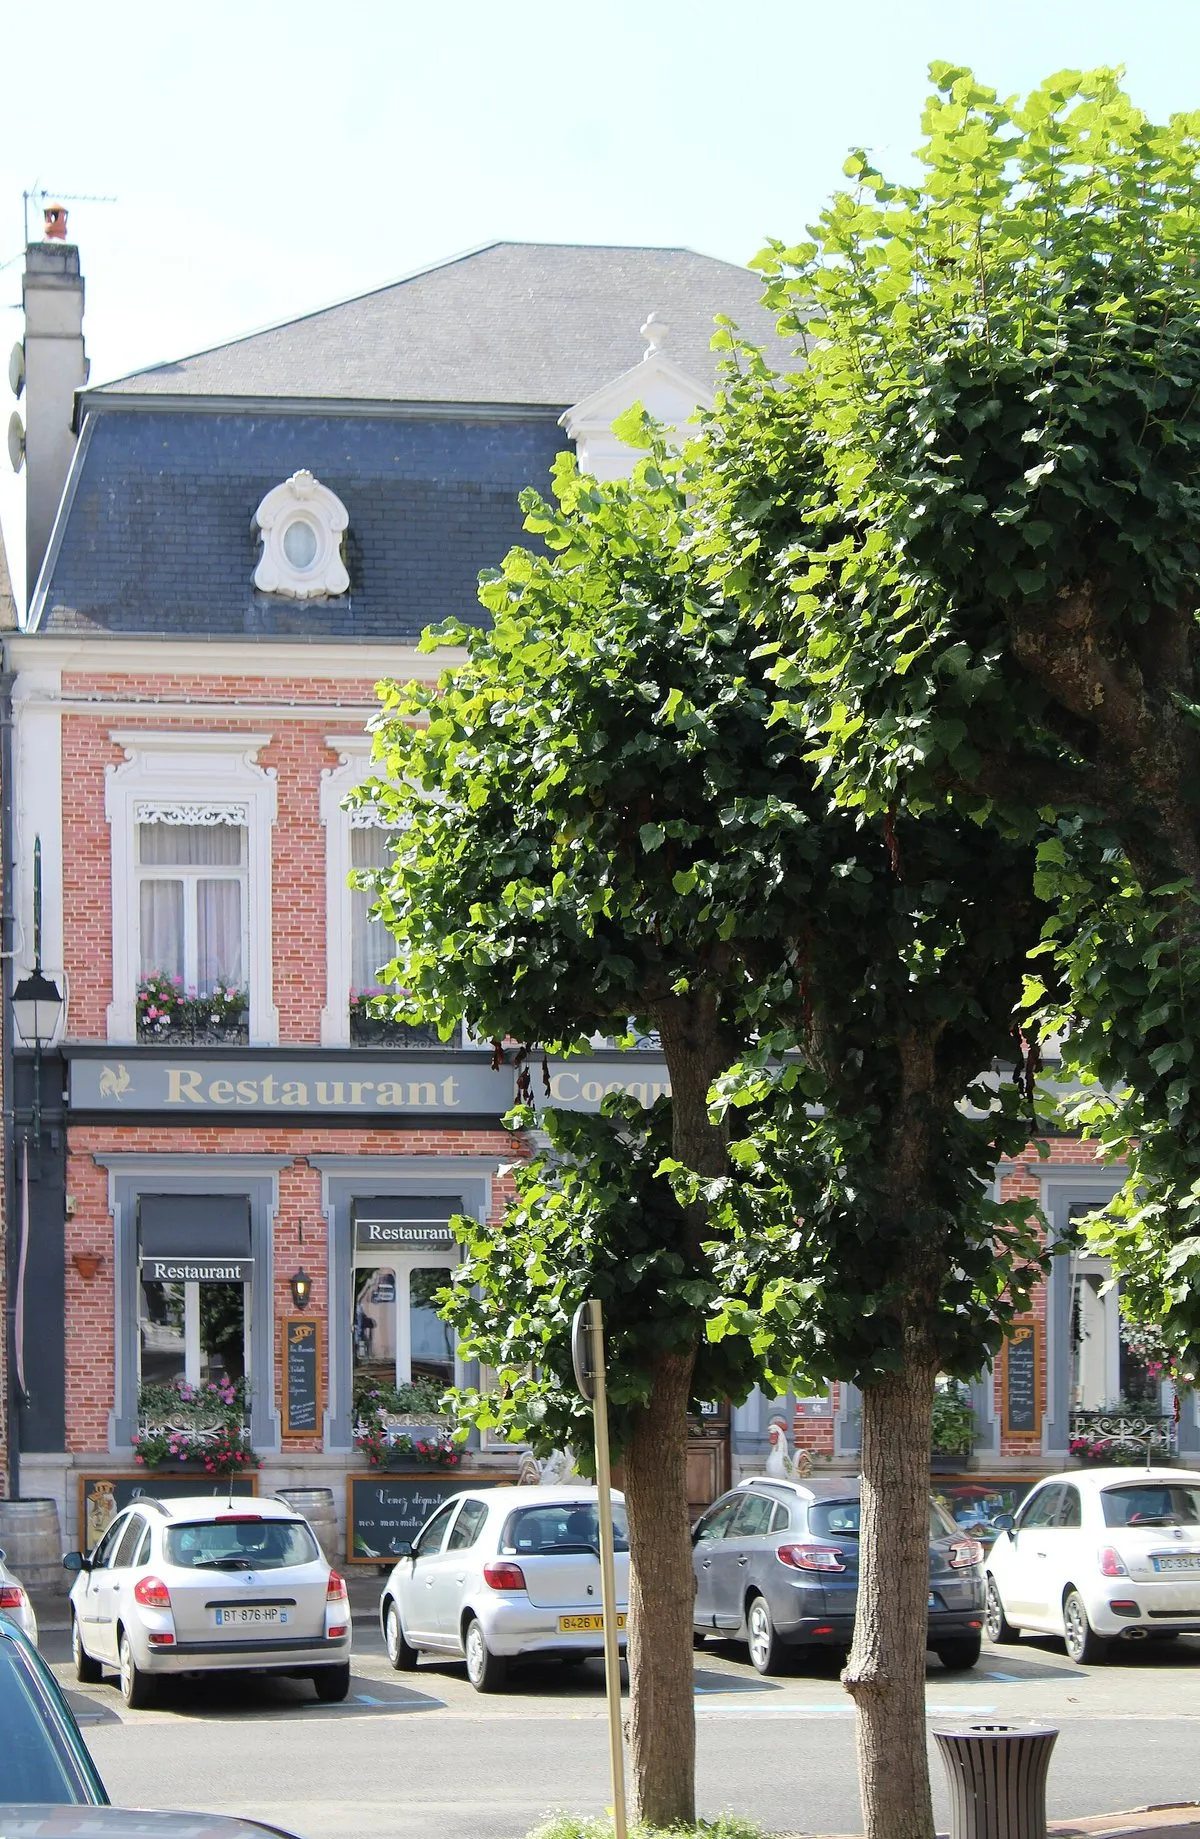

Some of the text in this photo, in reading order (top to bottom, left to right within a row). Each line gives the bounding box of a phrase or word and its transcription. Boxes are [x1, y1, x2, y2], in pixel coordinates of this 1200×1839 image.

[163, 1069, 460, 1107] Restaurant
[369, 1225, 455, 1240] Restaurant
[154, 1263, 241, 1279] Restaurant
[223, 1608, 278, 1621] BT-876-HP
[563, 1617, 590, 1628] 8426
